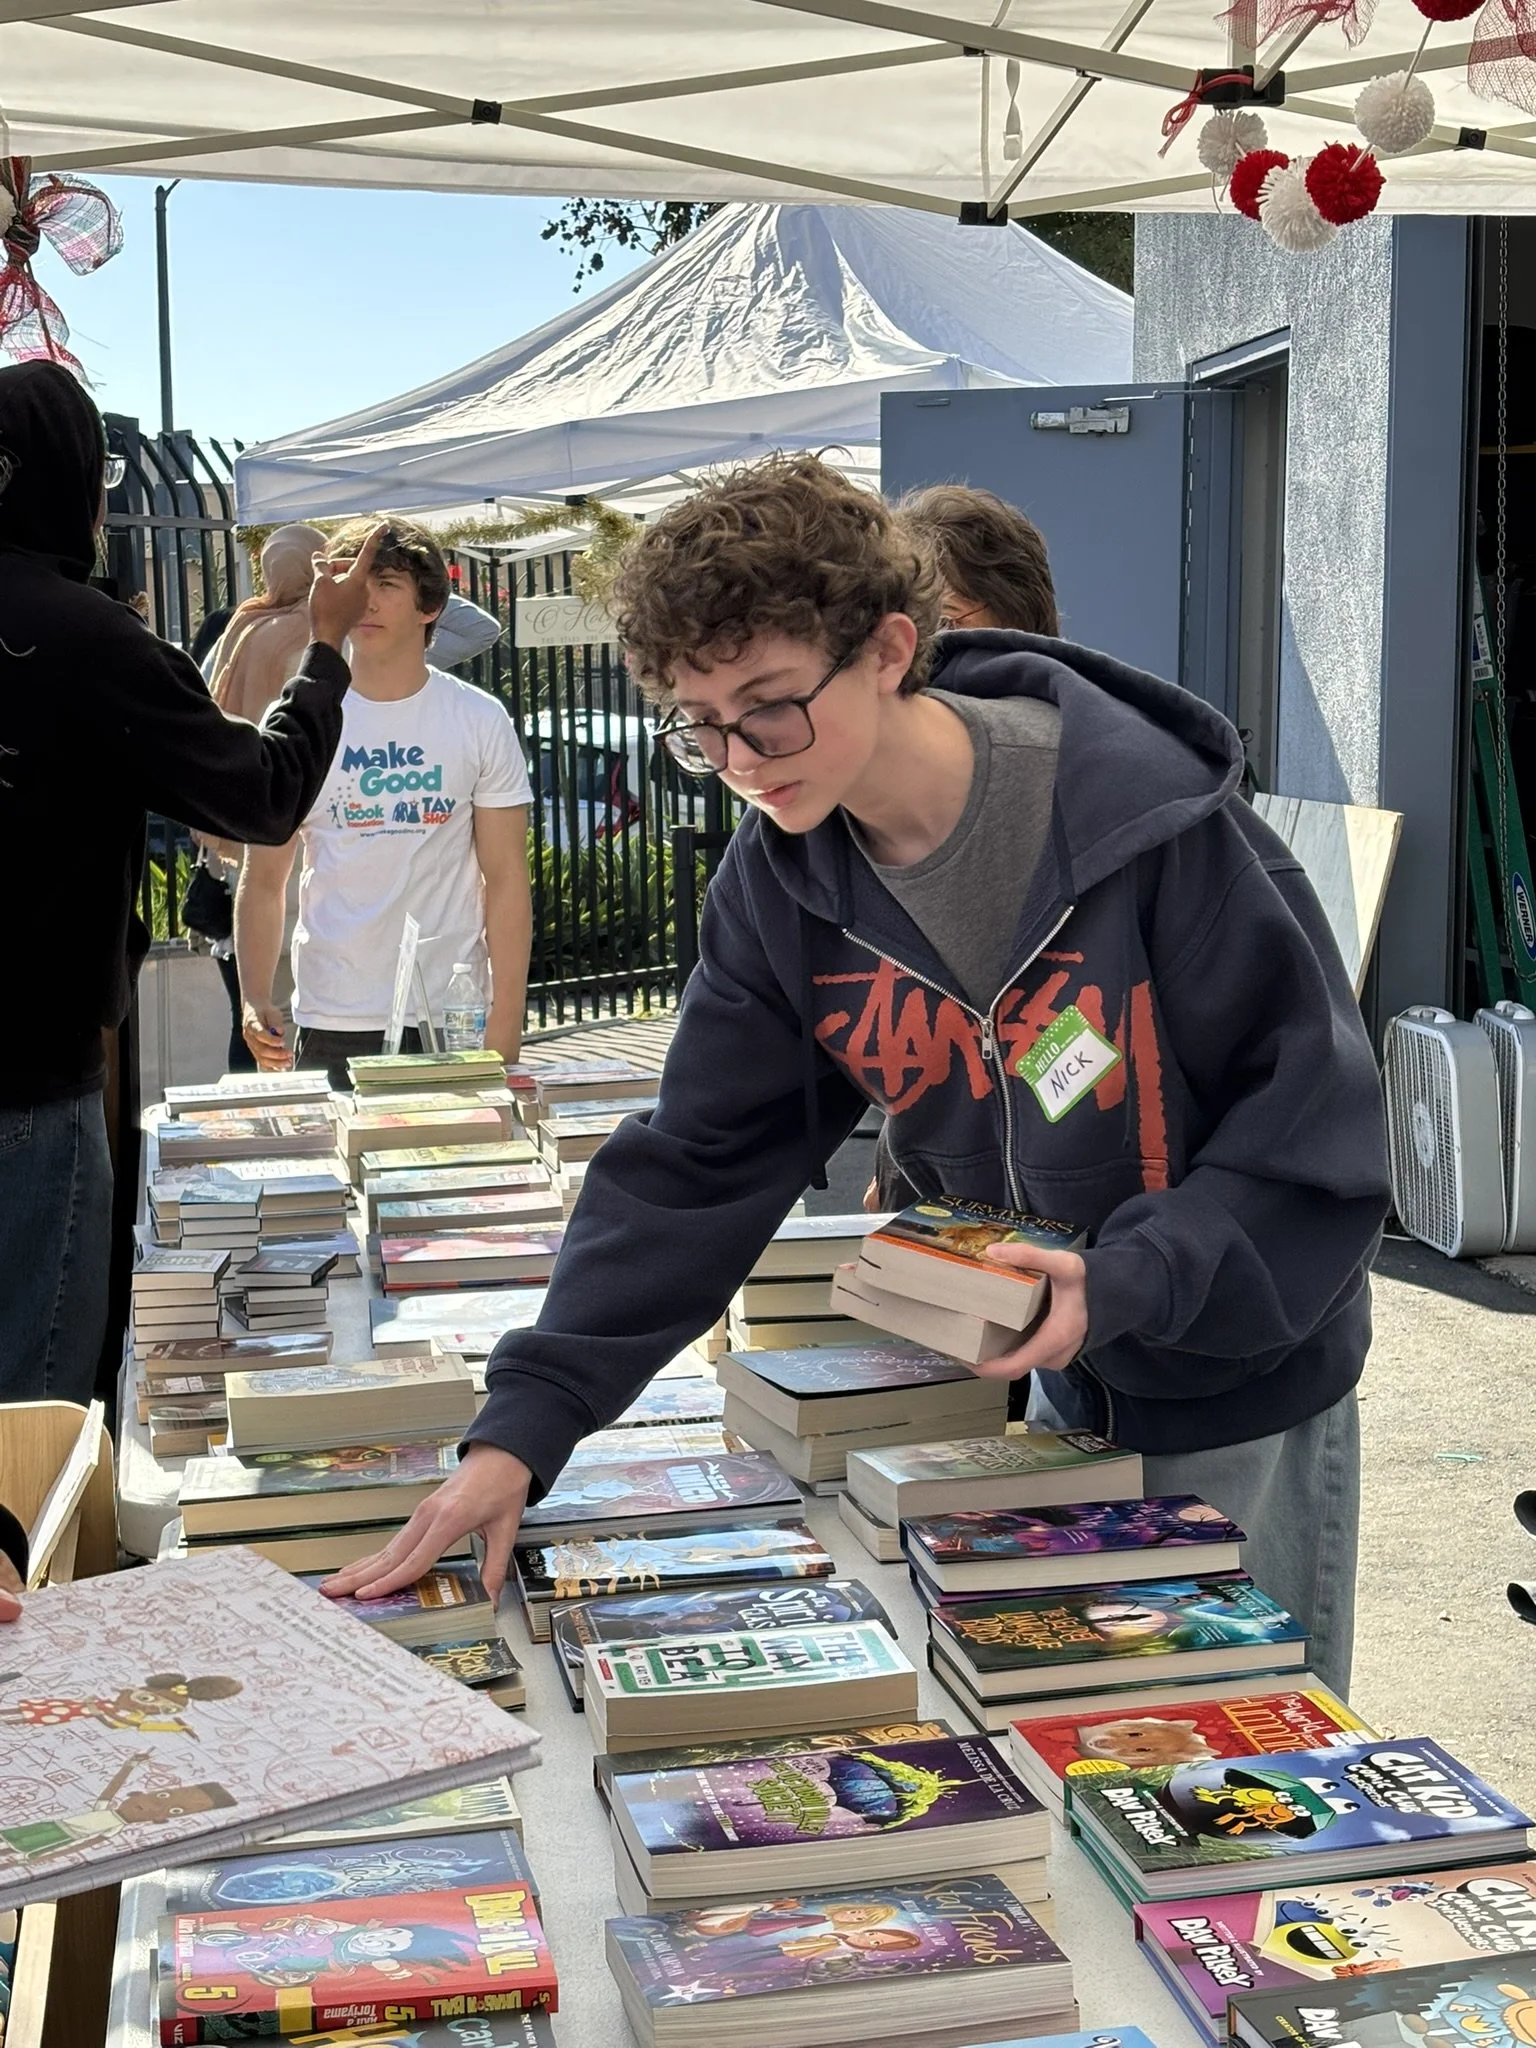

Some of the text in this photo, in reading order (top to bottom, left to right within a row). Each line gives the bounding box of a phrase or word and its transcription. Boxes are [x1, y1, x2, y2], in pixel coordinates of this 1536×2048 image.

[341, 741, 424, 774] Make
[360, 764, 442, 797] Good
[344, 804, 384, 821] book
[349, 802, 361, 810] the
[422, 797, 456, 813] TAY
[422, 812, 453, 825] SHO
[1517, 891, 1533, 943] WERNER
[1035, 1042, 1060, 1075] HELLO
[1050, 1051, 1093, 1098] NICK
[939, 1195, 1075, 1236] SURVIVORS
[666, 1464, 718, 1503] UNICO
[954, 1616, 1013, 1645] BIRDS
[994, 1610, 1064, 1650] LANGUAGE
[1044, 1616, 1106, 1643] SECRET
[447, 1643, 492, 1678] Beast
[660, 1646, 710, 1682] BEA
[712, 1646, 757, 1670] TO
[761, 1635, 810, 1671] WAY
[816, 1632, 869, 1665] THE
[1216, 1694, 1310, 1754] Humphre
[1279, 1706, 1331, 1734] World
[957, 1742, 988, 1773] MELISSA
[979, 1773, 996, 1784] DE
[997, 1793, 1021, 1810] CRUZ
[1370, 1752, 1449, 1783] CAT
[746, 1777, 801, 1824] SOCIETY
[1100, 1787, 1147, 1810] DAV
[1383, 1790, 1422, 1814] CLUB
[893, 1880, 982, 1912] Star
[1467, 1879, 1536, 1916] CAT
[931, 1910, 1023, 1964] Friends
[1170, 1917, 1220, 1944] DAV
[1479, 1925, 1521, 1953] CLUB
[183, 1985, 238, 2000] 5
[323, 2004, 377, 2020] Toriyama
[385, 2006, 416, 2021] 5
[1298, 2008, 1344, 2040] DAV
[174, 2023, 184, 2044] VIZ
